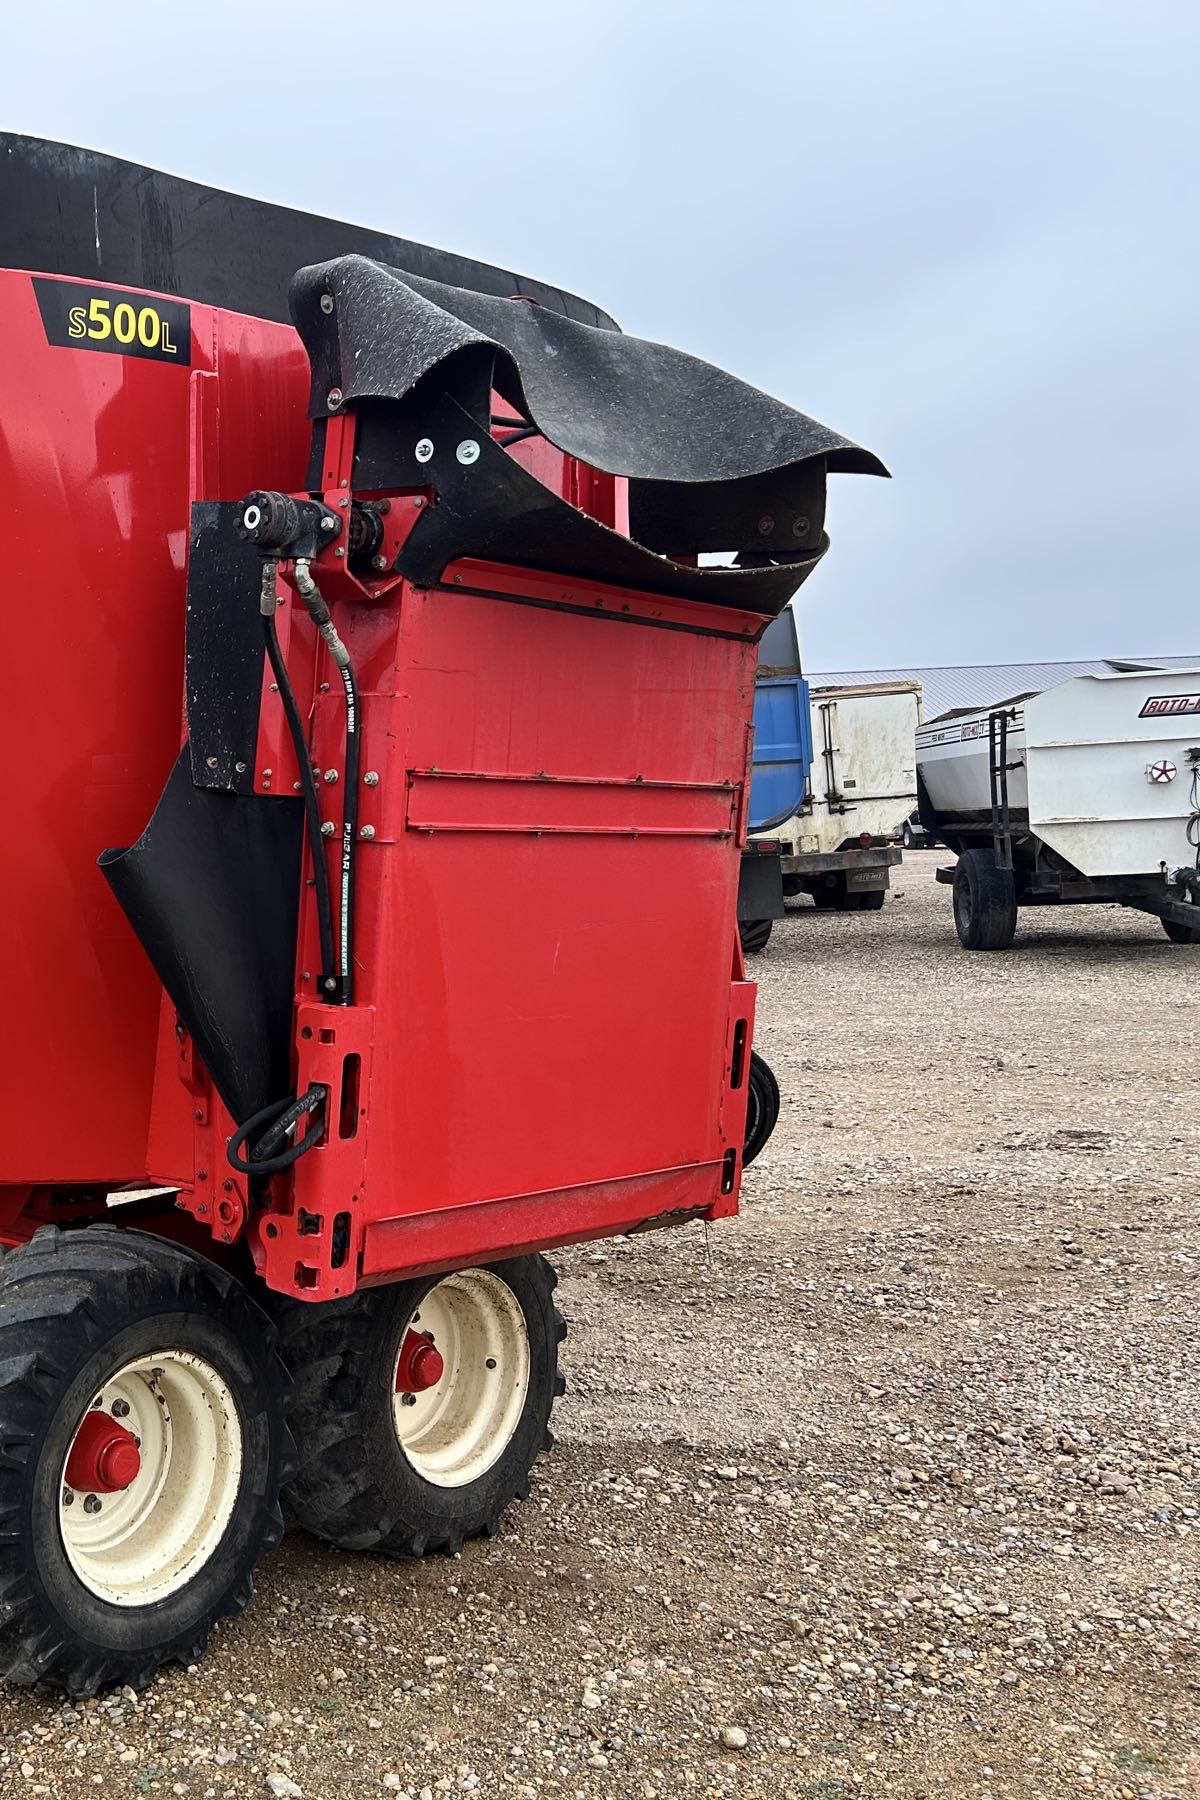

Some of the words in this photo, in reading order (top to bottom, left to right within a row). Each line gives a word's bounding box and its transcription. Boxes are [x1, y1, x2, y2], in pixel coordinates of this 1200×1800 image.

[68, 298, 177, 353] S500L
[344, 680, 353, 693] BAR
[342, 822, 352, 870] PULSAR
